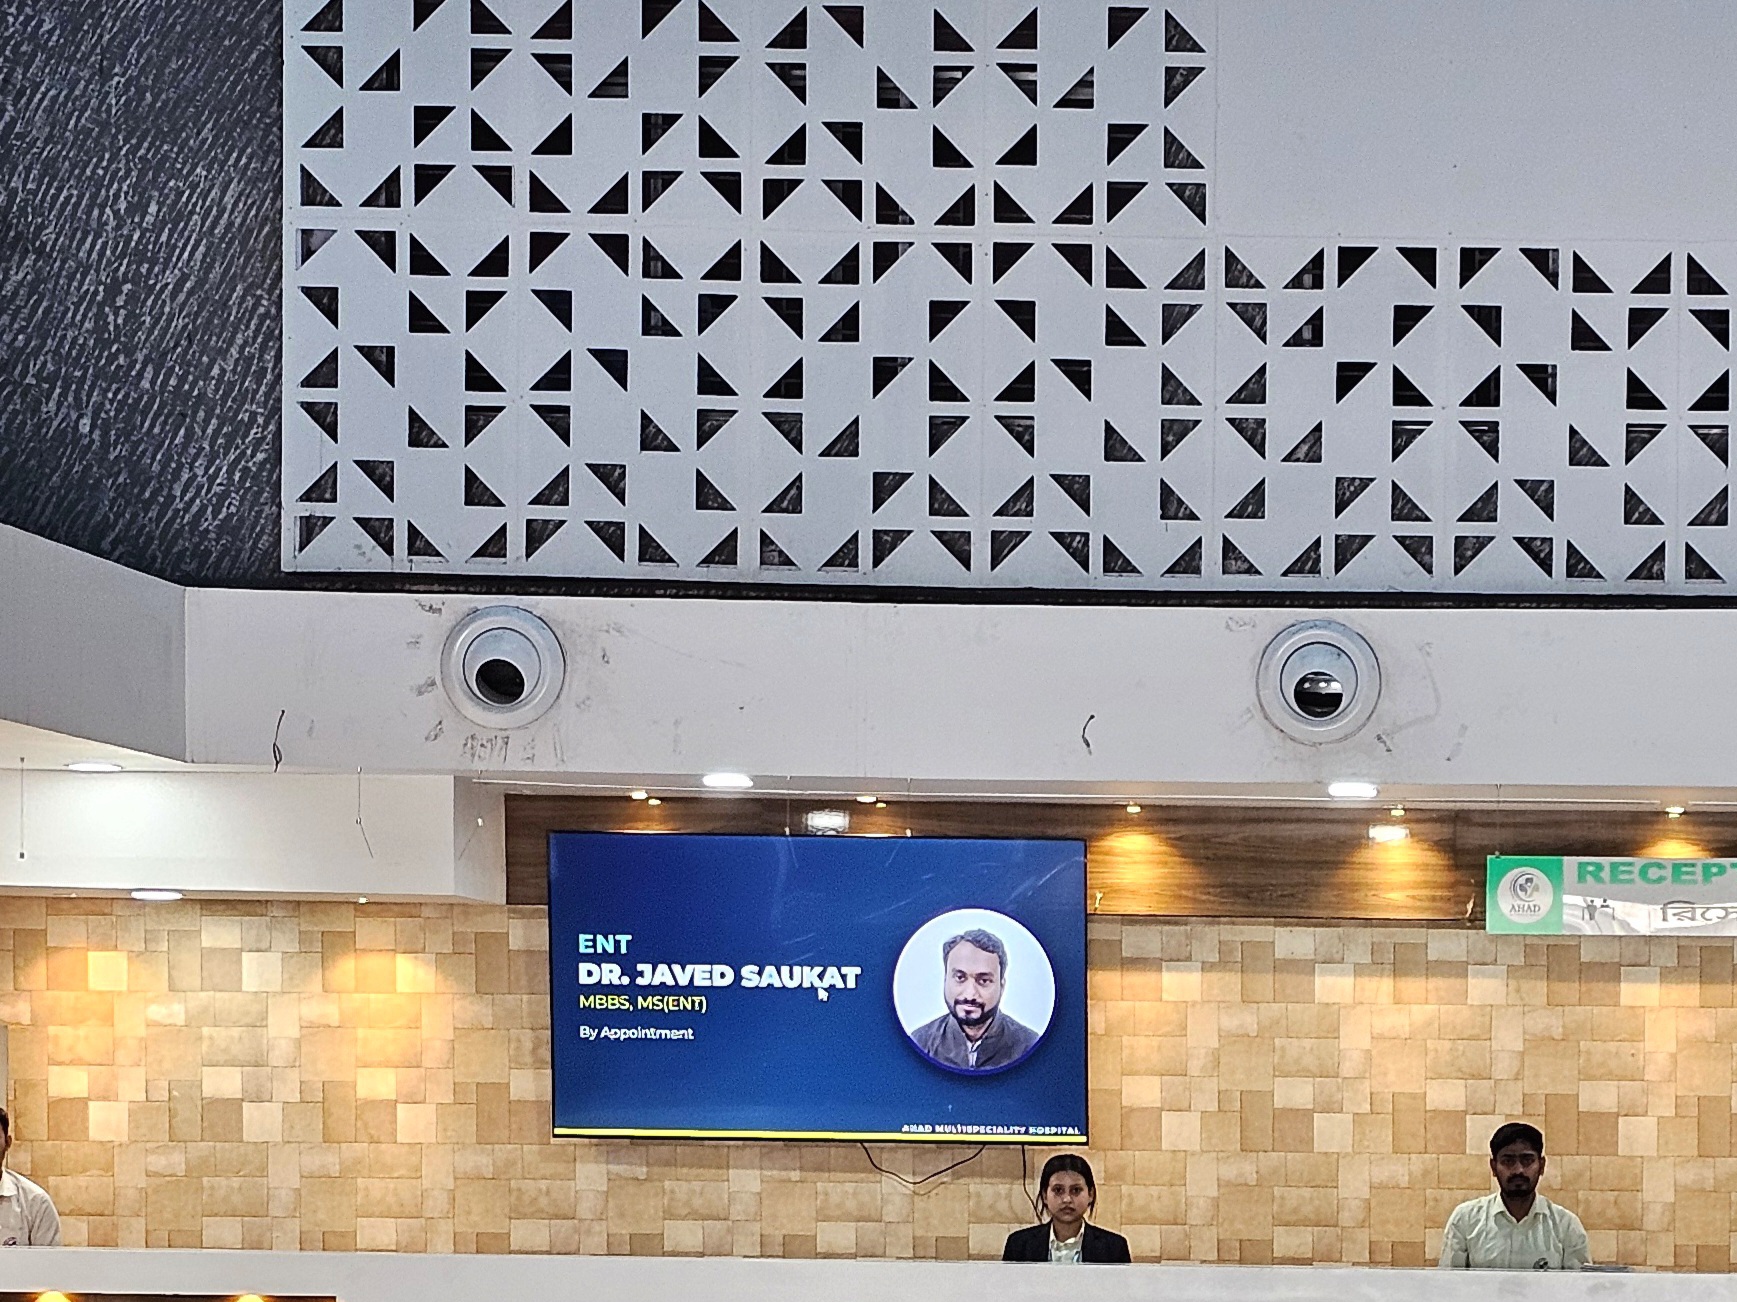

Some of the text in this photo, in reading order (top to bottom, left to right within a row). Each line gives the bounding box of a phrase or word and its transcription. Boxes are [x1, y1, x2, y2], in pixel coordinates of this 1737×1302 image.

[1509, 903, 1541, 915] AHAD
[578, 934, 632, 954] ENT
[578, 963, 862, 989] DR. JAVED SAUKAT
[579, 994, 707, 1014] MBBS, MS(ENT)
[579, 1025, 695, 1041] By Appointment
